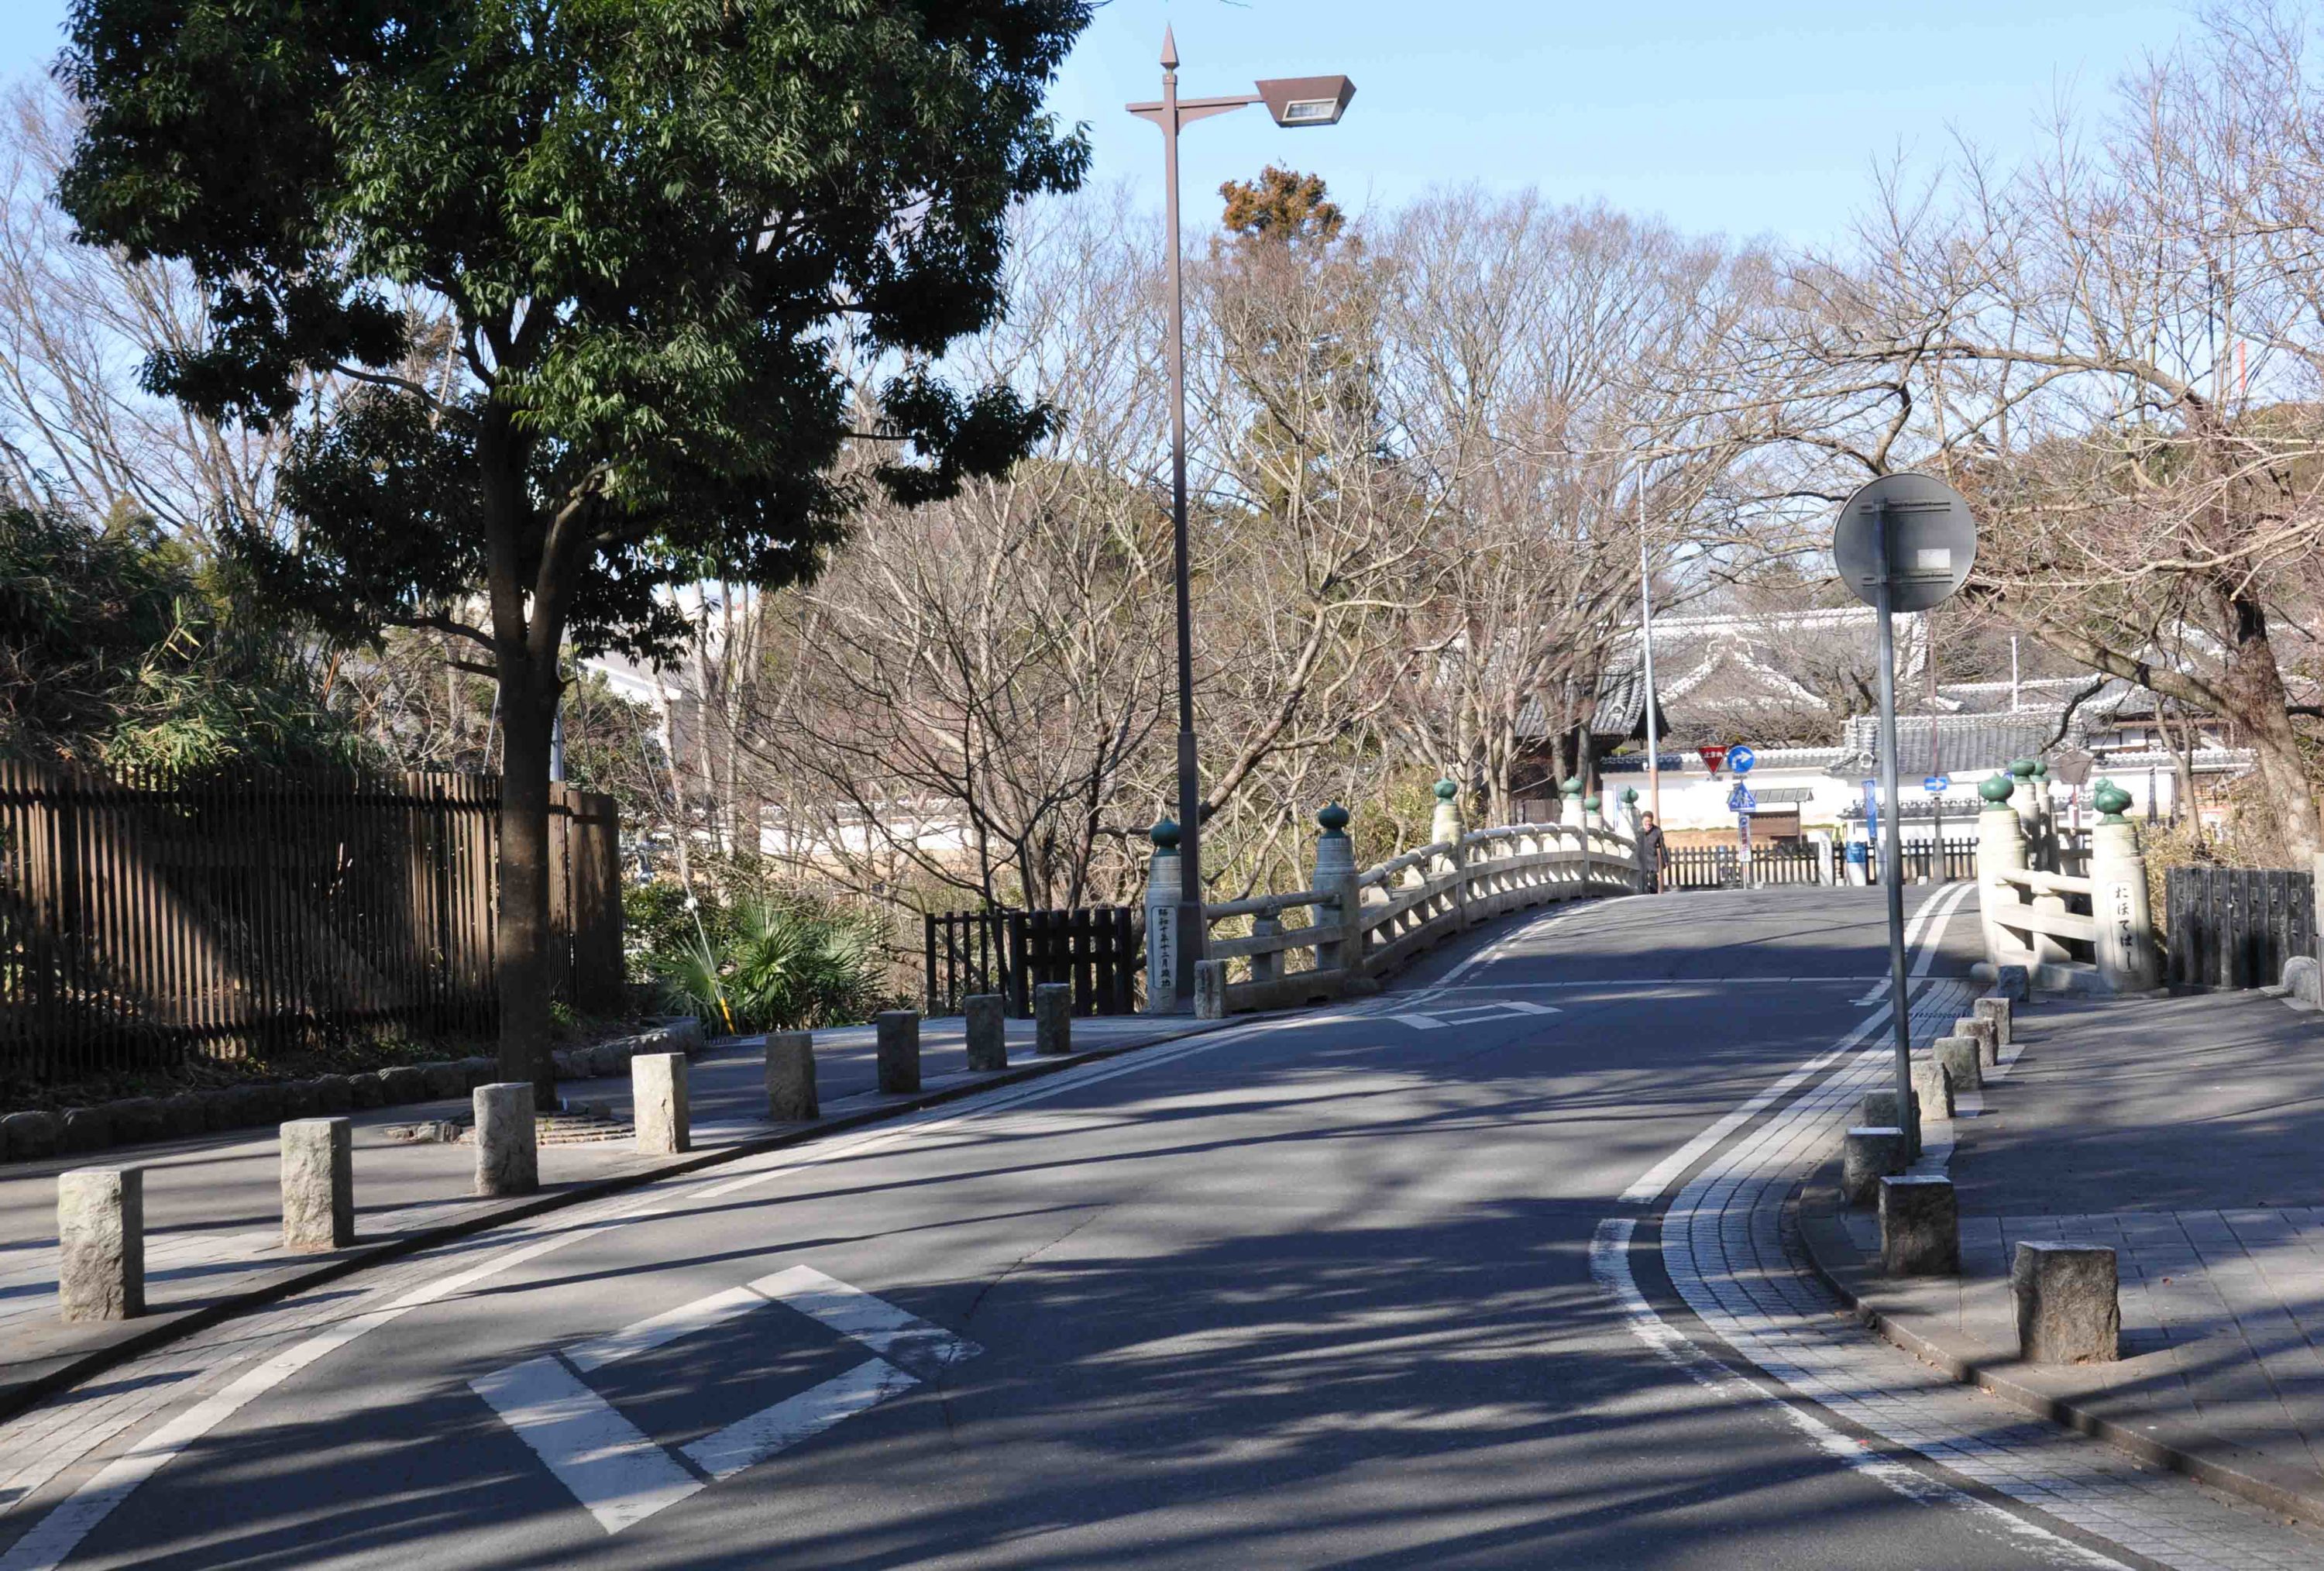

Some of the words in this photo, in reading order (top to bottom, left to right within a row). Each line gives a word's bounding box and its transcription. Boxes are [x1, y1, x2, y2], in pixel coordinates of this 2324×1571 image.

[2116, 886, 2133, 969] おほてはし
